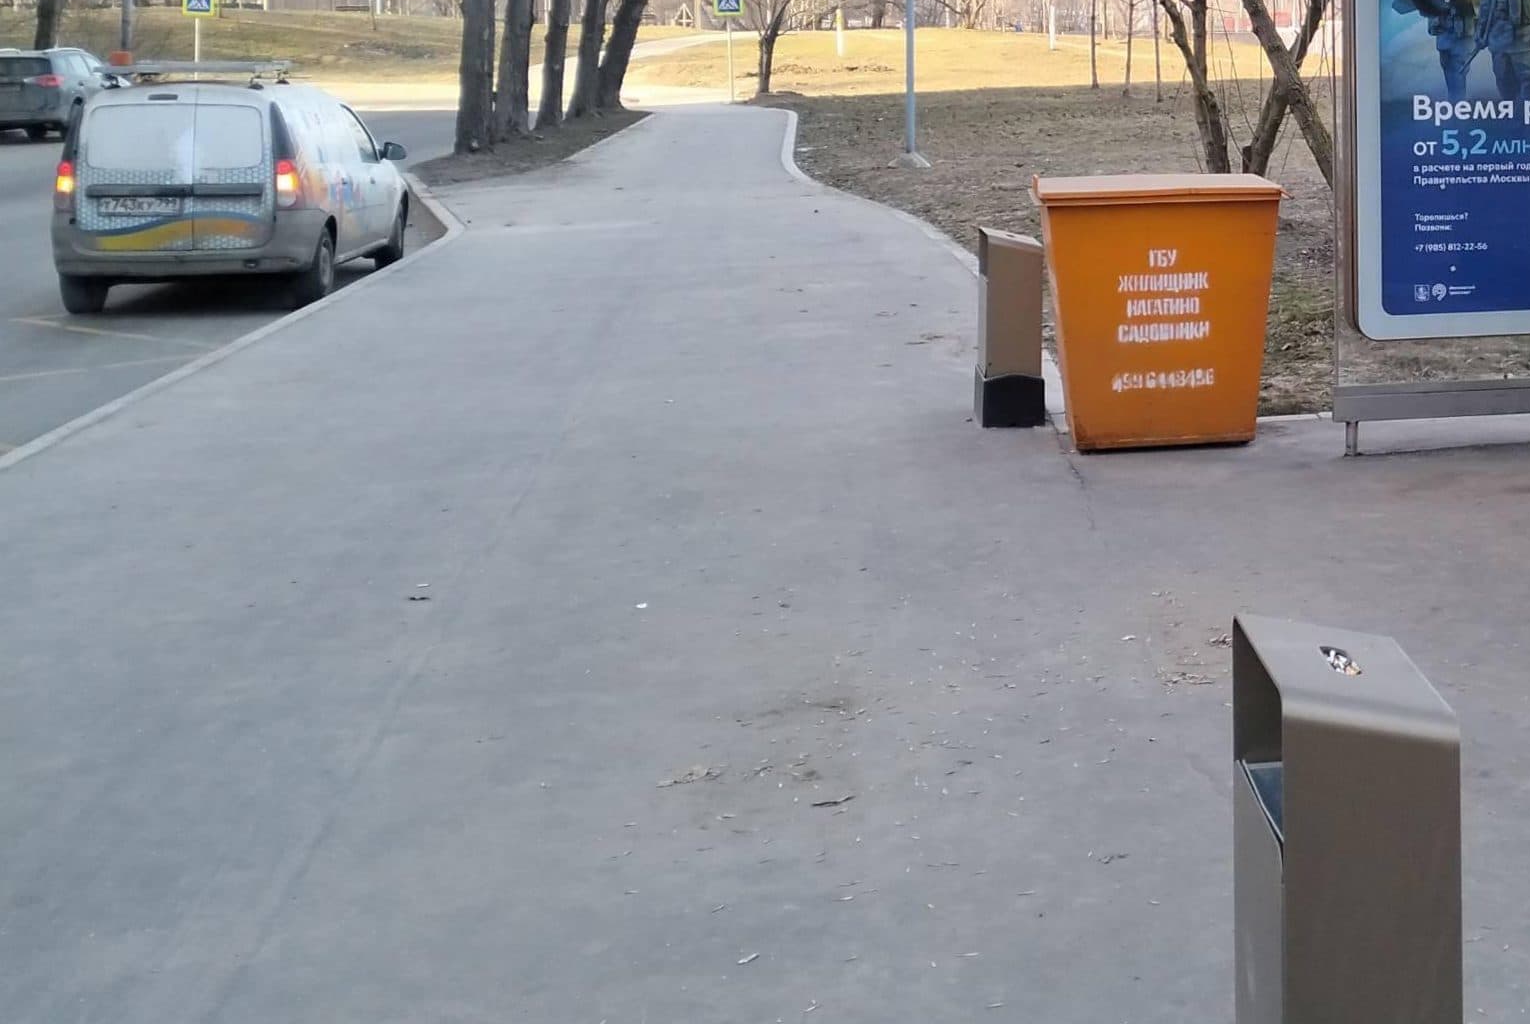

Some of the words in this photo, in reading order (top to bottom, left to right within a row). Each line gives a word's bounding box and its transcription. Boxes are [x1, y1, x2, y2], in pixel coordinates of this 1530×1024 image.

[1412, 94, 1515, 126] Время
[1441, 128, 1488, 160] 5,2
[1413, 165, 1420, 173] в
[1463, 164, 1475, 172] на
[1476, 161, 1515, 173] первый
[1413, 175, 1488, 187] Правительства
[1490, 174, 1530, 183] Москвы
[1414, 212, 1469, 223] Торопишься?
[1148, 248, 1178, 268] ГБУ
[1117, 272, 1210, 293] ЖИЛИЩНИК
[1126, 296, 1201, 318] НАГАТИНО
